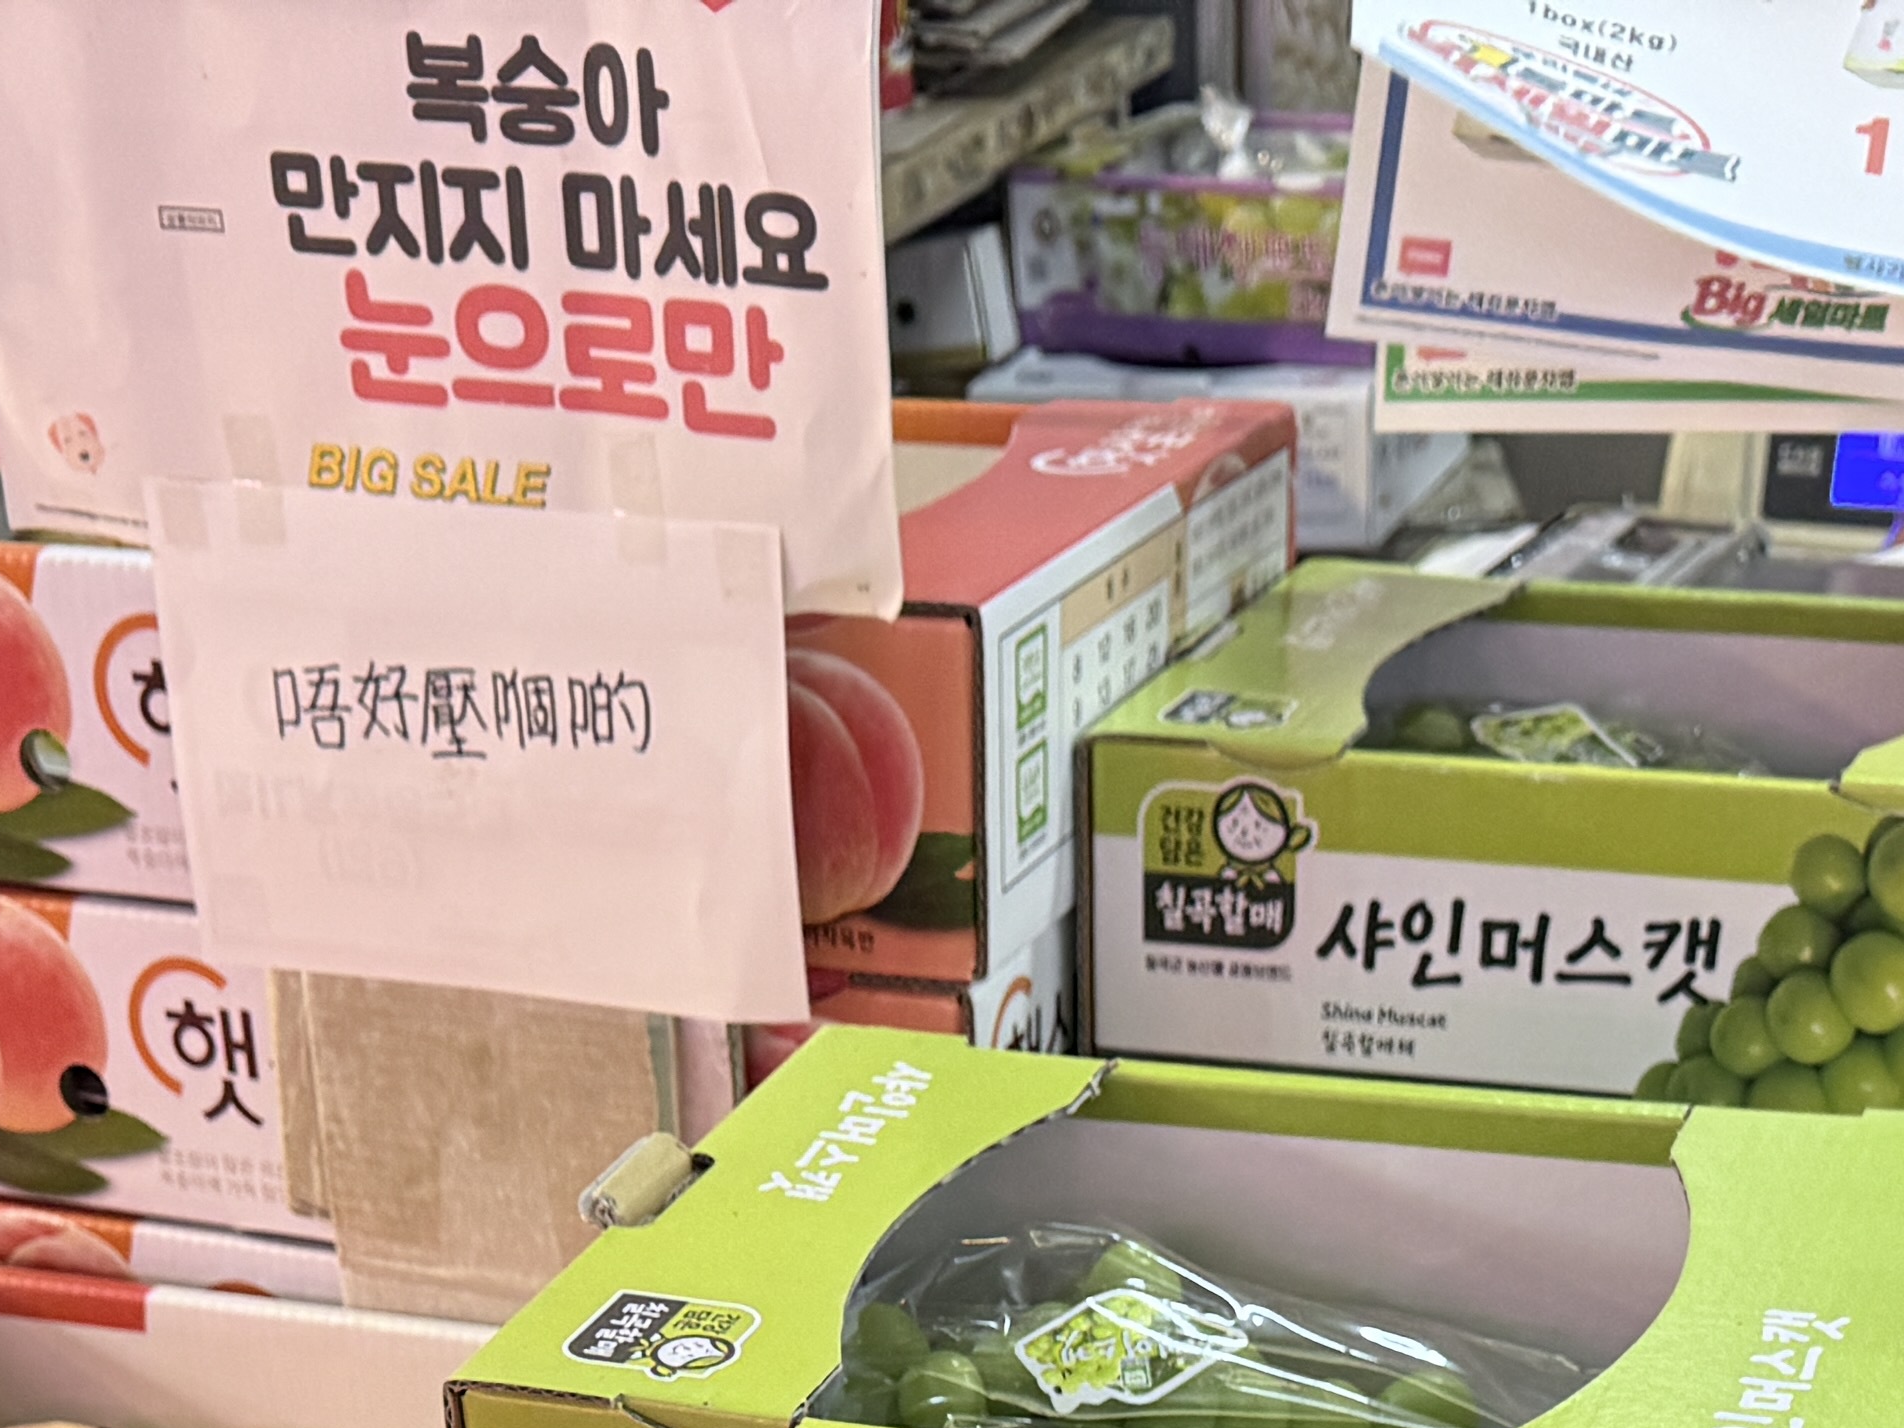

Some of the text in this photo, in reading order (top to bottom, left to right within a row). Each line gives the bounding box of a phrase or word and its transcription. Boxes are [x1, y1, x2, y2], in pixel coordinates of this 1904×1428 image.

[405, 31, 669, 156] 복숭아
[270, 150, 829, 291] 만지지 마세요
[1696, 272, 1767, 327] Big
[341, 270, 784, 441] 눈으로만
[309, 444, 551, 508] BIG SALE
[1153, 882, 1286, 937] 칠곡할매
[1316, 897, 1723, 1005] 샤인머스캣
[1320, 1002, 1448, 1030] Shine Muscat
[758, 1060, 934, 1203] 샤인머스캣
